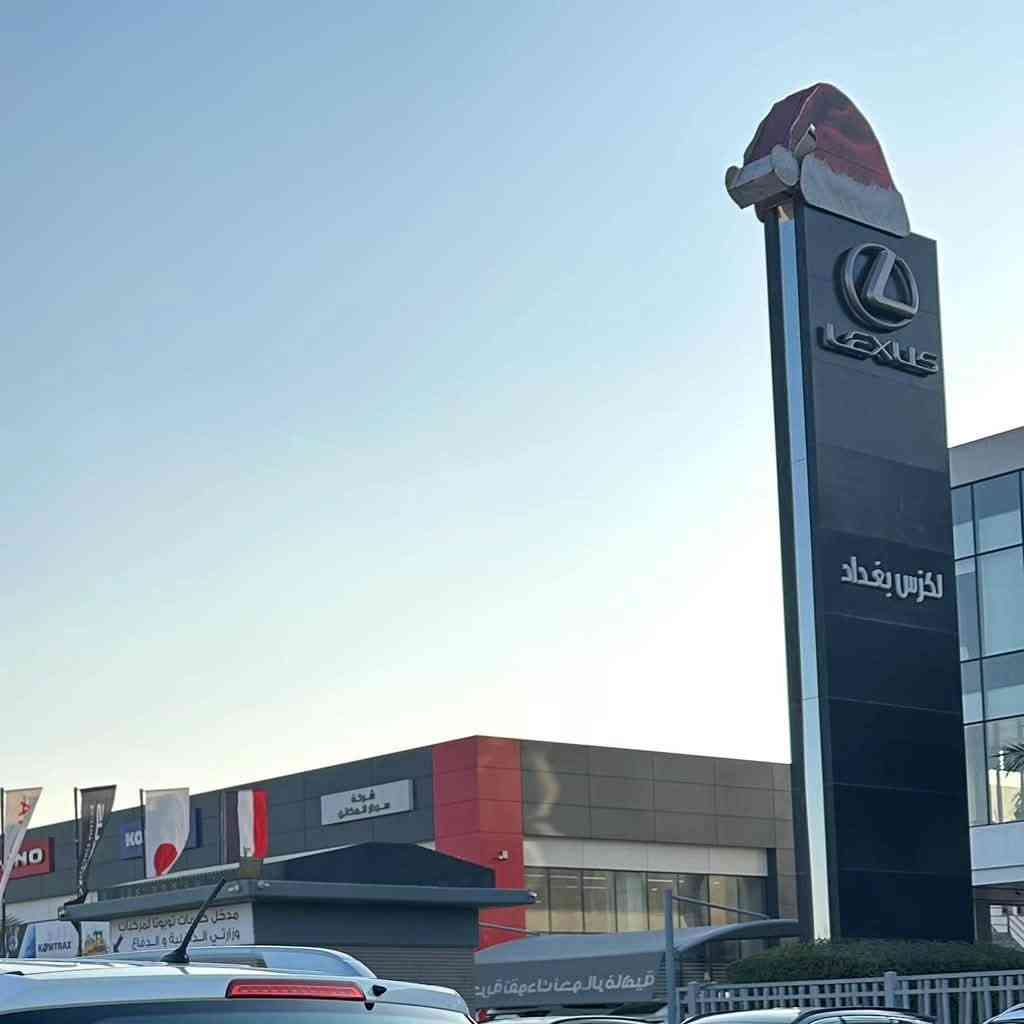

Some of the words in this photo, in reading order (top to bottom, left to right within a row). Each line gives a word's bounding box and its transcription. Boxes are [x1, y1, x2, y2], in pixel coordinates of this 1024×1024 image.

[821, 323, 939, 375] LEXUS
[841, 555, 892, 598] بغداد
[895, 569, 943, 603] لكزس
[211, 908, 239, 924] مدخل
